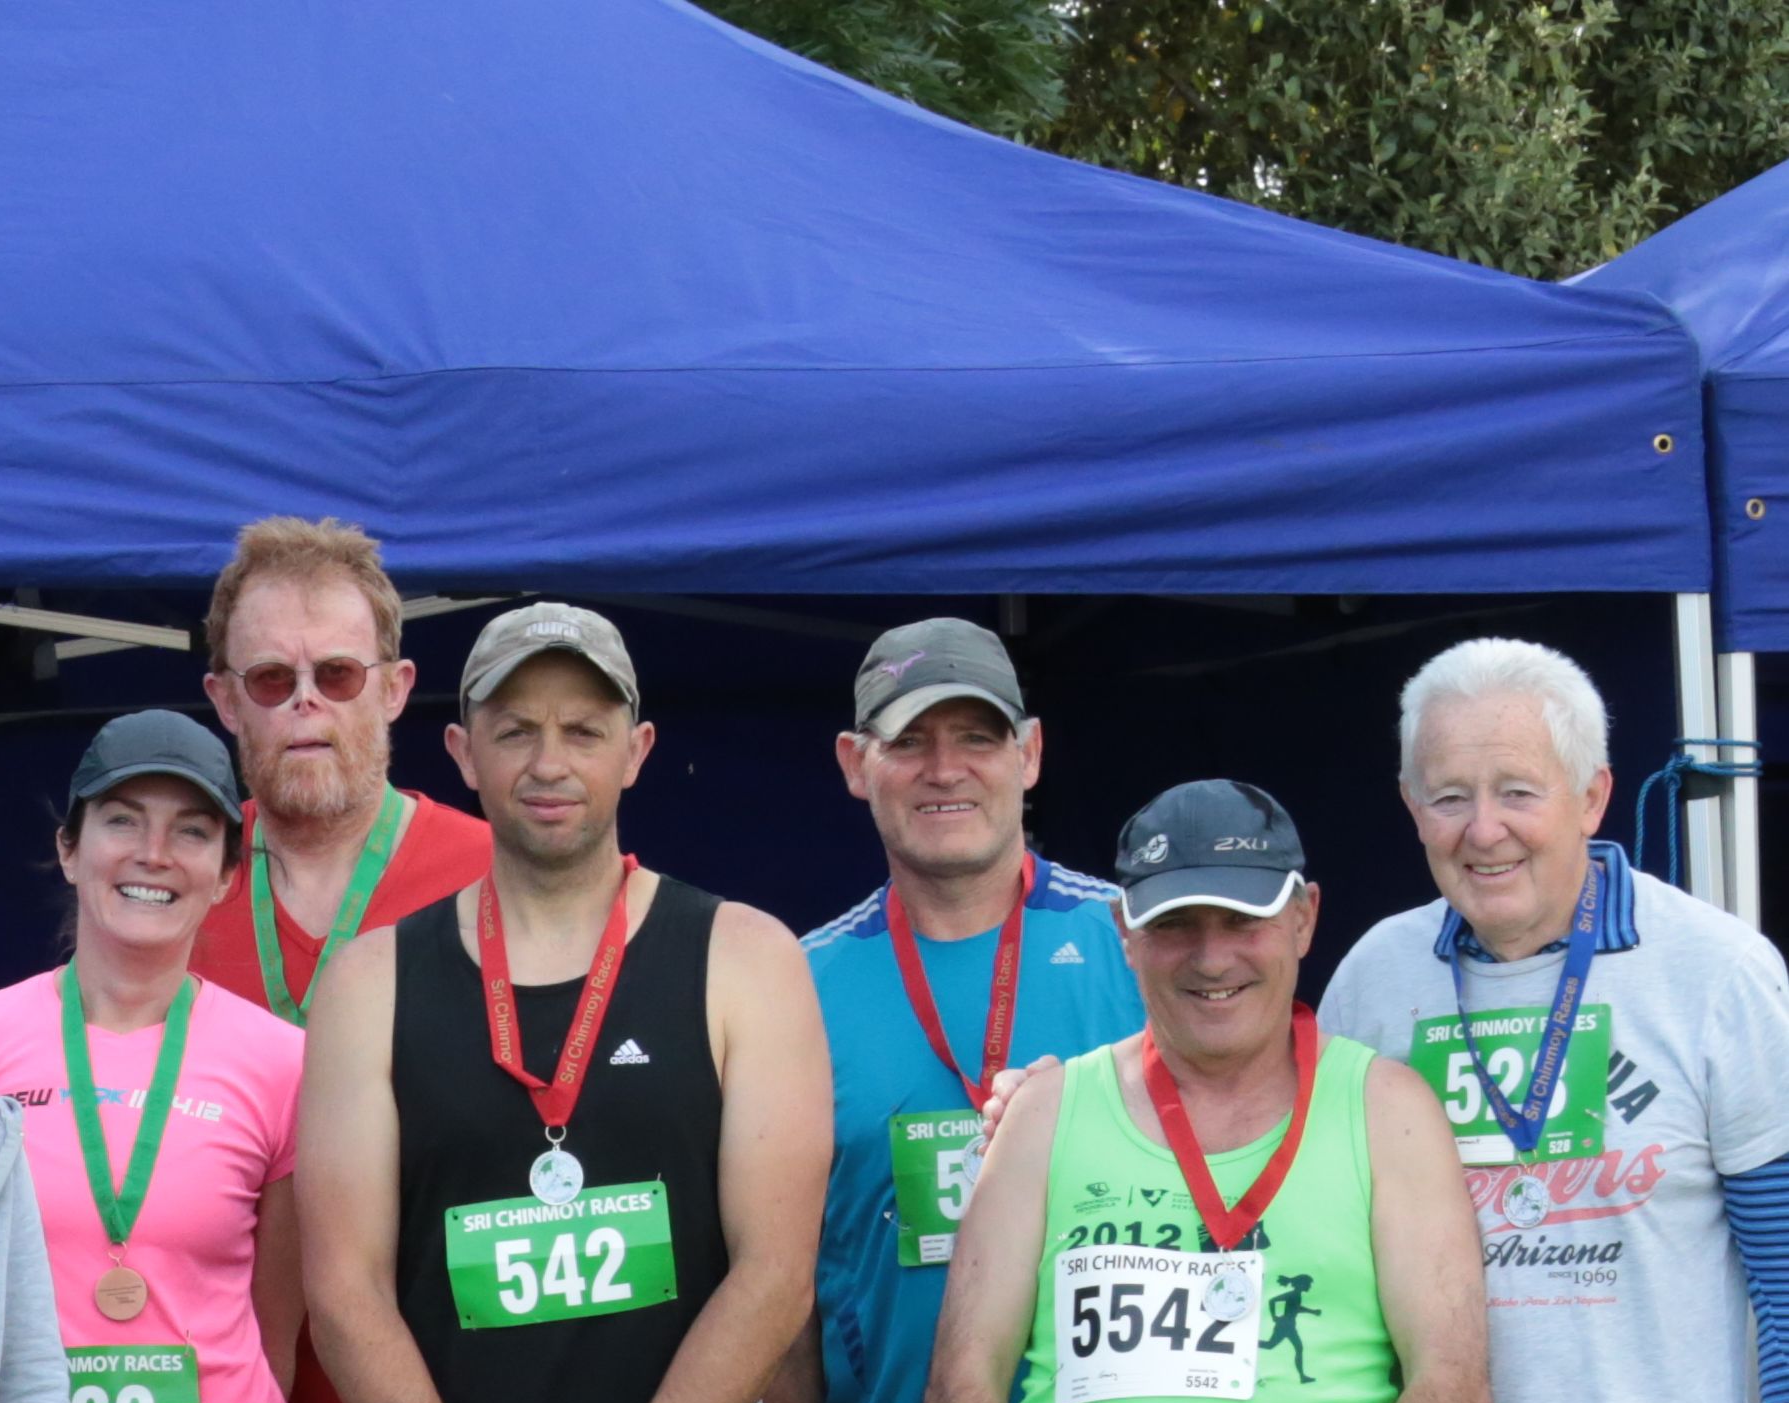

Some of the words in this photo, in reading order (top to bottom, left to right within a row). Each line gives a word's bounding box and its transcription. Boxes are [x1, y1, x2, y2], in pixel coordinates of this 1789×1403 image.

[1213, 836, 1268, 851] 2XU
[590, 944, 617, 990] Races
[997, 942, 1014, 987] Races
[491, 978, 505, 997] Sri
[494, 1000, 513, 1062] Chinmo
[567, 991, 604, 1060] Chinmoy
[987, 988, 1009, 1057] Chinmoy
[1425, 1025, 1451, 1043] SRI
[609, 1053, 650, 1065] adidas
[1524, 1096, 1543, 1122] Sri
[1534, 1026, 1567, 1097] Chinmoy
[1552, 976, 1579, 1025] Races
[559, 1061, 576, 1085] Sri
[5, 1088, 54, 1108] EW
[906, 1122, 935, 1141] SRI
[937, 1117, 984, 1138] CHIN
[1548, 1138, 1572, 1155] 528
[463, 1212, 492, 1233] SRI
[495, 1200, 586, 1228] CHINMOY
[590, 1192, 653, 1216] RACES
[1068, 1221, 1183, 1251] 2012
[1483, 1233, 1623, 1268] Arizona
[494, 1226, 634, 1316] 542
[1067, 1255, 1088, 1276] SRI
[1091, 1254, 1183, 1274] CHINMOY
[1572, 1267, 1618, 1287] 1969
[67, 1355, 121, 1374] NMOY
[124, 1354, 184, 1373] RACES
[1185, 1375, 1220, 1390] 5542
